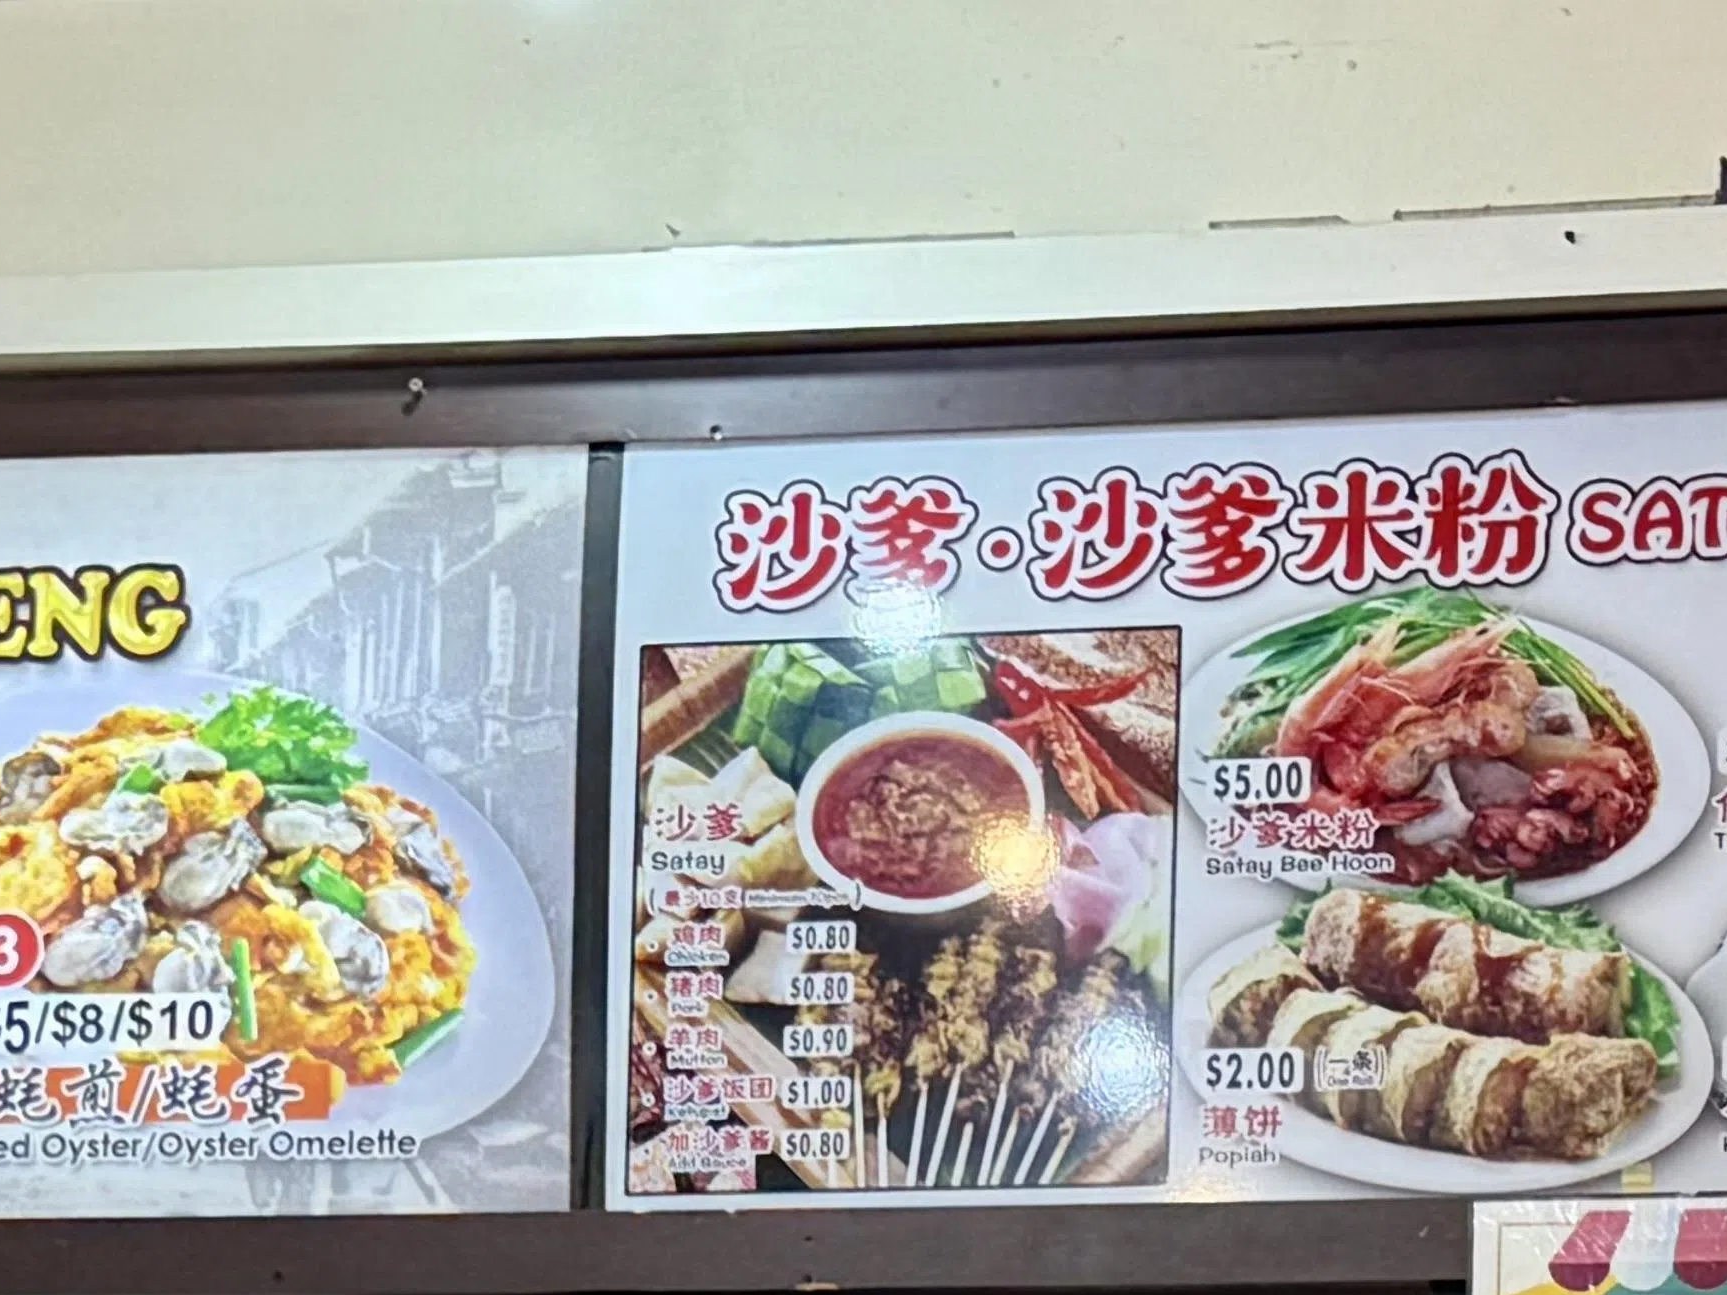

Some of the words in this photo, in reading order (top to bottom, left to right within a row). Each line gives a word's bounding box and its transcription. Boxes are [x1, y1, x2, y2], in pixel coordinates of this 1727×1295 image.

[1214, 761, 1303, 799] $5.00
[655, 803, 744, 841] 沙爹
[1209, 814, 1375, 848] 沙爹米粉
[651, 852, 725, 876] Satay
[1206, 857, 1272, 878] Satay
[1281, 856, 1323, 872] Bee
[1332, 855, 1392, 872] Hoon
[792, 925, 850, 950] $0.80
[790, 977, 848, 1000] $0.80
[789, 1028, 847, 1052] $0.90
[1206, 1052, 1294, 1090] $2.00
[788, 1080, 846, 1105] $1.00
[1203, 1105, 1282, 1138] 薄饼
[42, 1133, 257, 1165] Oyster/Oyster
[268, 1130, 416, 1157] Omelette
[786, 1132, 845, 1157] $0.80
[1199, 1143, 1276, 1169] Popiah
